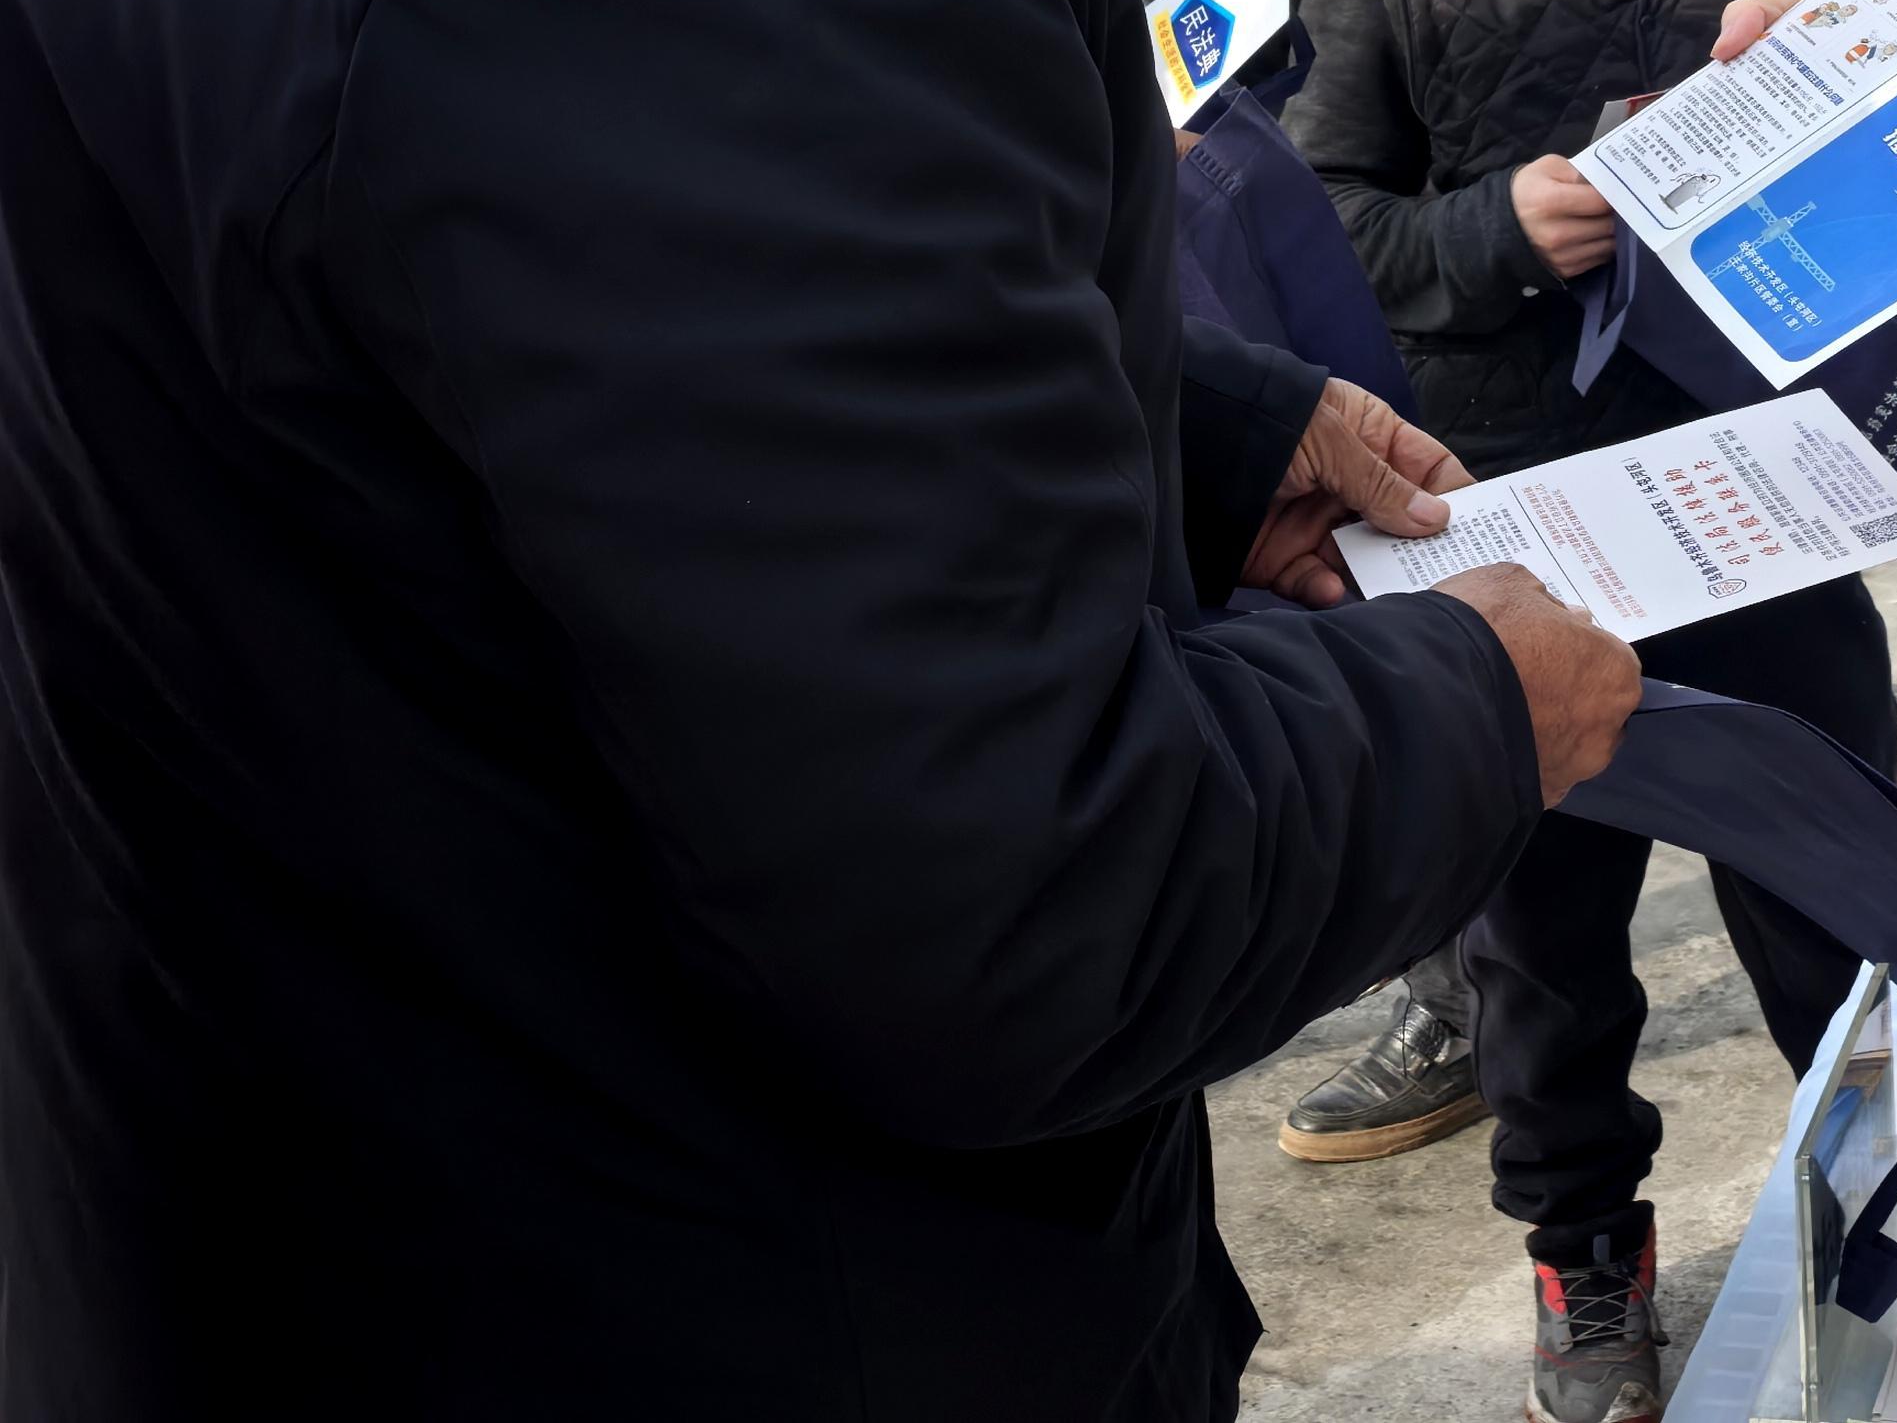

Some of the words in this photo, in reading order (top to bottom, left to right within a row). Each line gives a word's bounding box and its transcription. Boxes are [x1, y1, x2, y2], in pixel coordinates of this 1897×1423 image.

[1180, 5, 1221, 77] 民法典
[1664, 467, 1751, 566] 司法局法律援助
[1693, 459, 1785, 557] 便民服务联系卡
